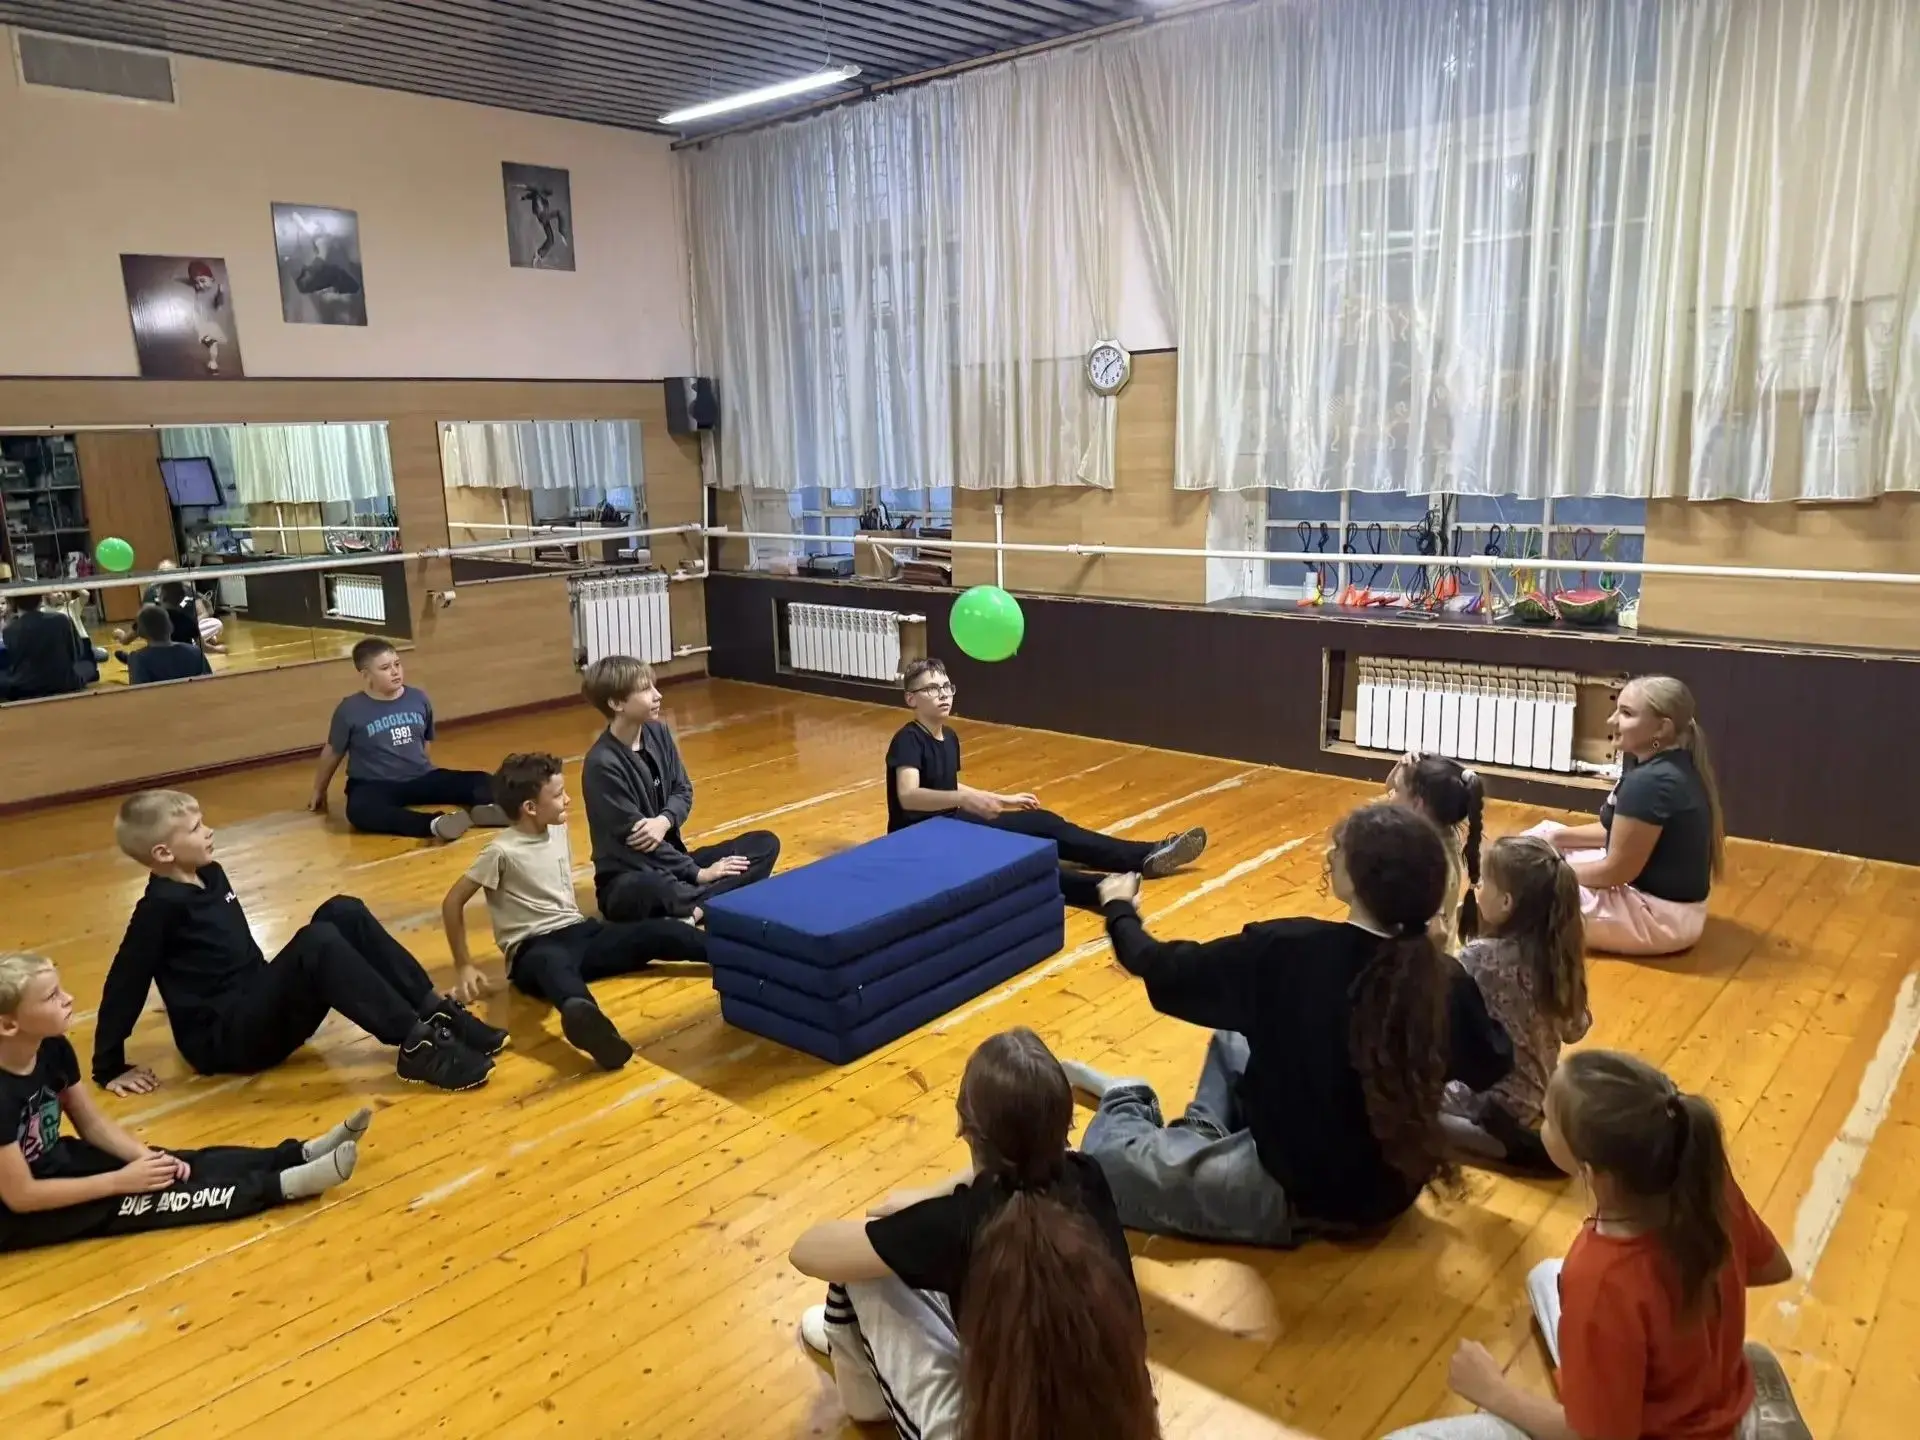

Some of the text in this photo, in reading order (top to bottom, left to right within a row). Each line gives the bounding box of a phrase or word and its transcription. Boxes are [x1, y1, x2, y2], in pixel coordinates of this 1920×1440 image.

[390, 725, 412, 740] 1981
[118, 1185, 236, 1216] ONE AND ONLY
